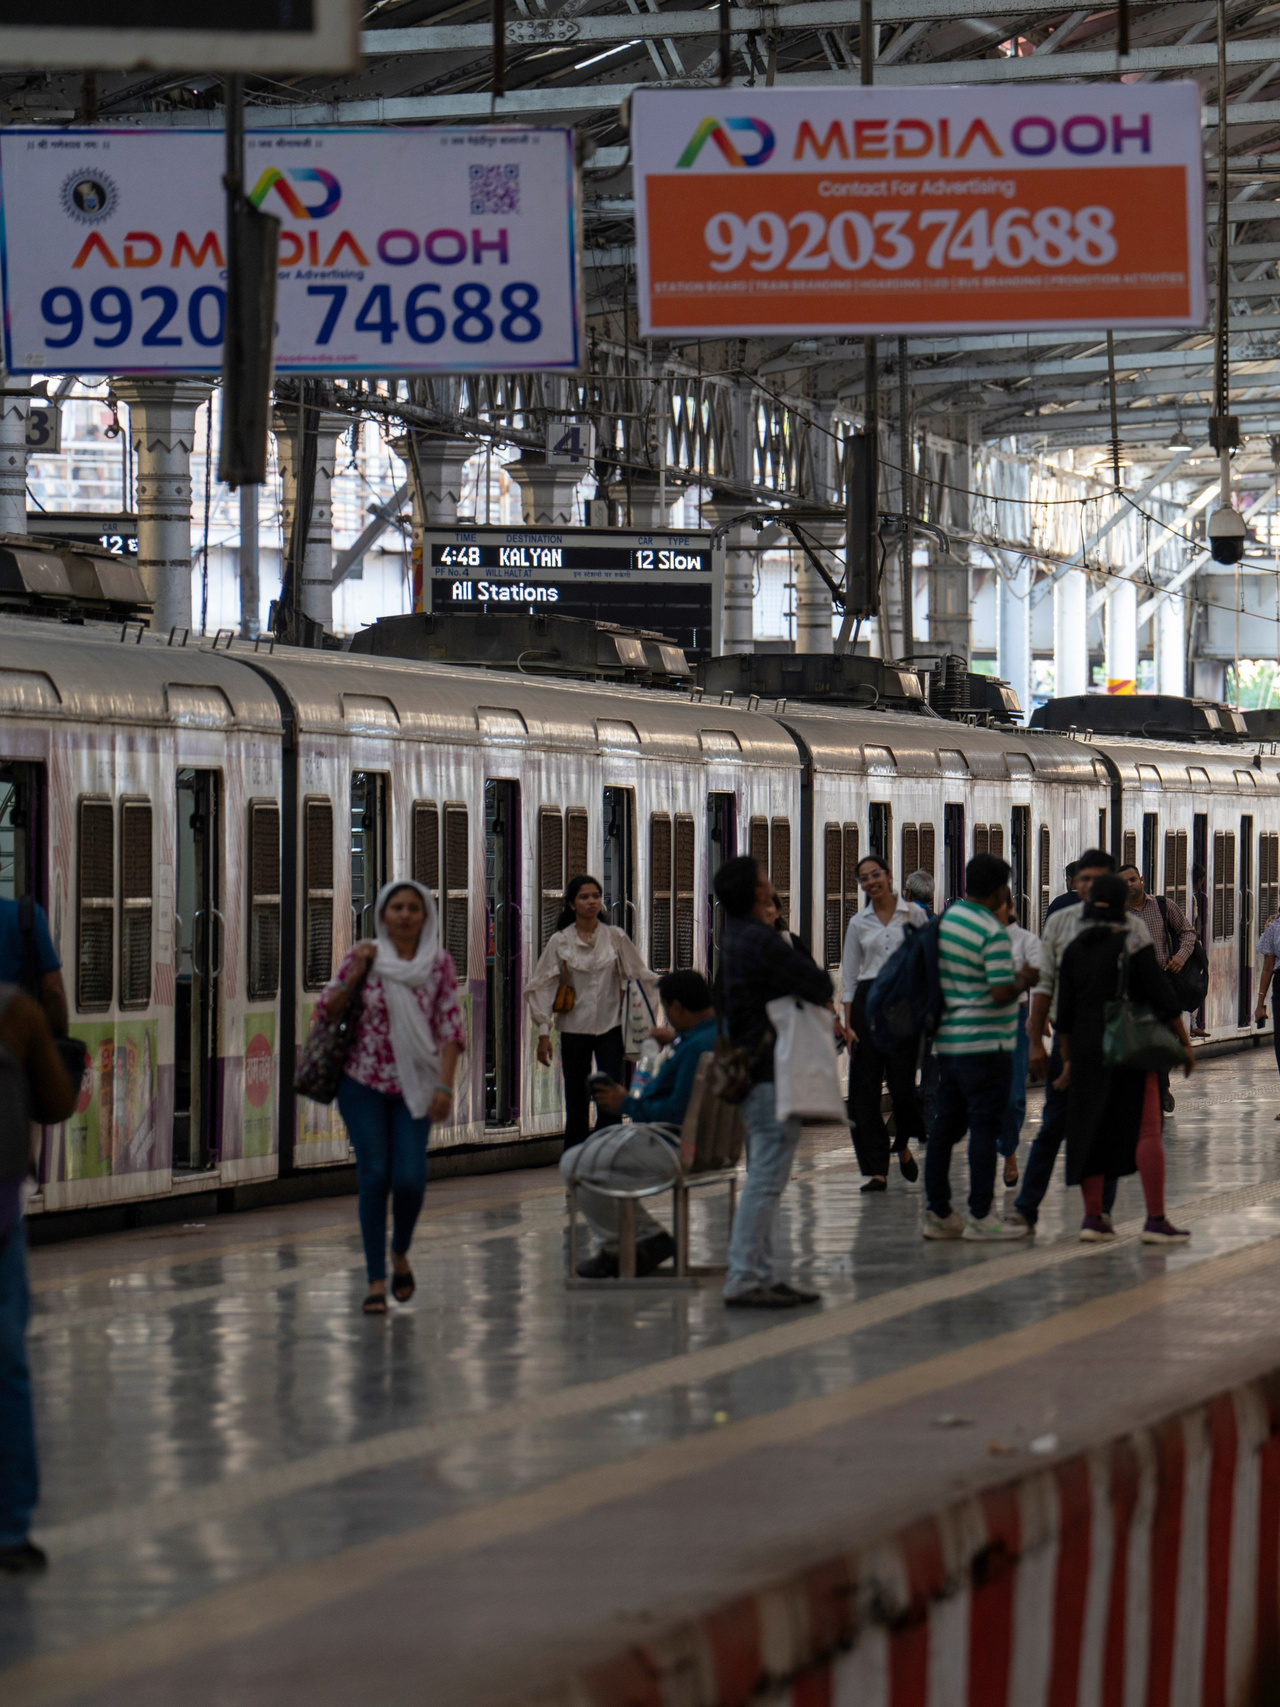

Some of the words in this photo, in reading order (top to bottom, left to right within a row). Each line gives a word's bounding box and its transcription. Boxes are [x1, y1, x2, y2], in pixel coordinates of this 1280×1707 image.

[793, 117, 1004, 160] MEDIA
[1011, 113, 1151, 158] OOH
[818, 180, 887, 197] Contact
[891, 179, 917, 196] For
[920, 177, 1016, 198] Advertising
[377, 227, 509, 267] OOH
[704, 209, 915, 273] 99203
[918, 204, 1118, 271] 74688
[40, 285, 280, 349] 9920
[307, 281, 542, 346] 74688
[26, 411, 50, 446] 3
[553, 427, 584, 463] 4
[103, 523, 118, 531] CAR
[455, 533, 477, 542] TIME
[506, 534, 563, 543] DESTINATION
[638, 537, 653, 545] CAR
[668, 537, 690, 546] TYPE
[435, 568, 445, 576] PF
[485, 569, 502, 577] WILL
[504, 569, 521, 577] HALT
[523, 569, 532, 577] AT
[440, 546, 481, 566] 4:48
[499, 547, 562, 567] KALYAN
[636, 550, 654, 569] 12
[658, 550, 702, 570] Slow
[452, 581, 473, 600] All
[477, 581, 559, 601] Stations
